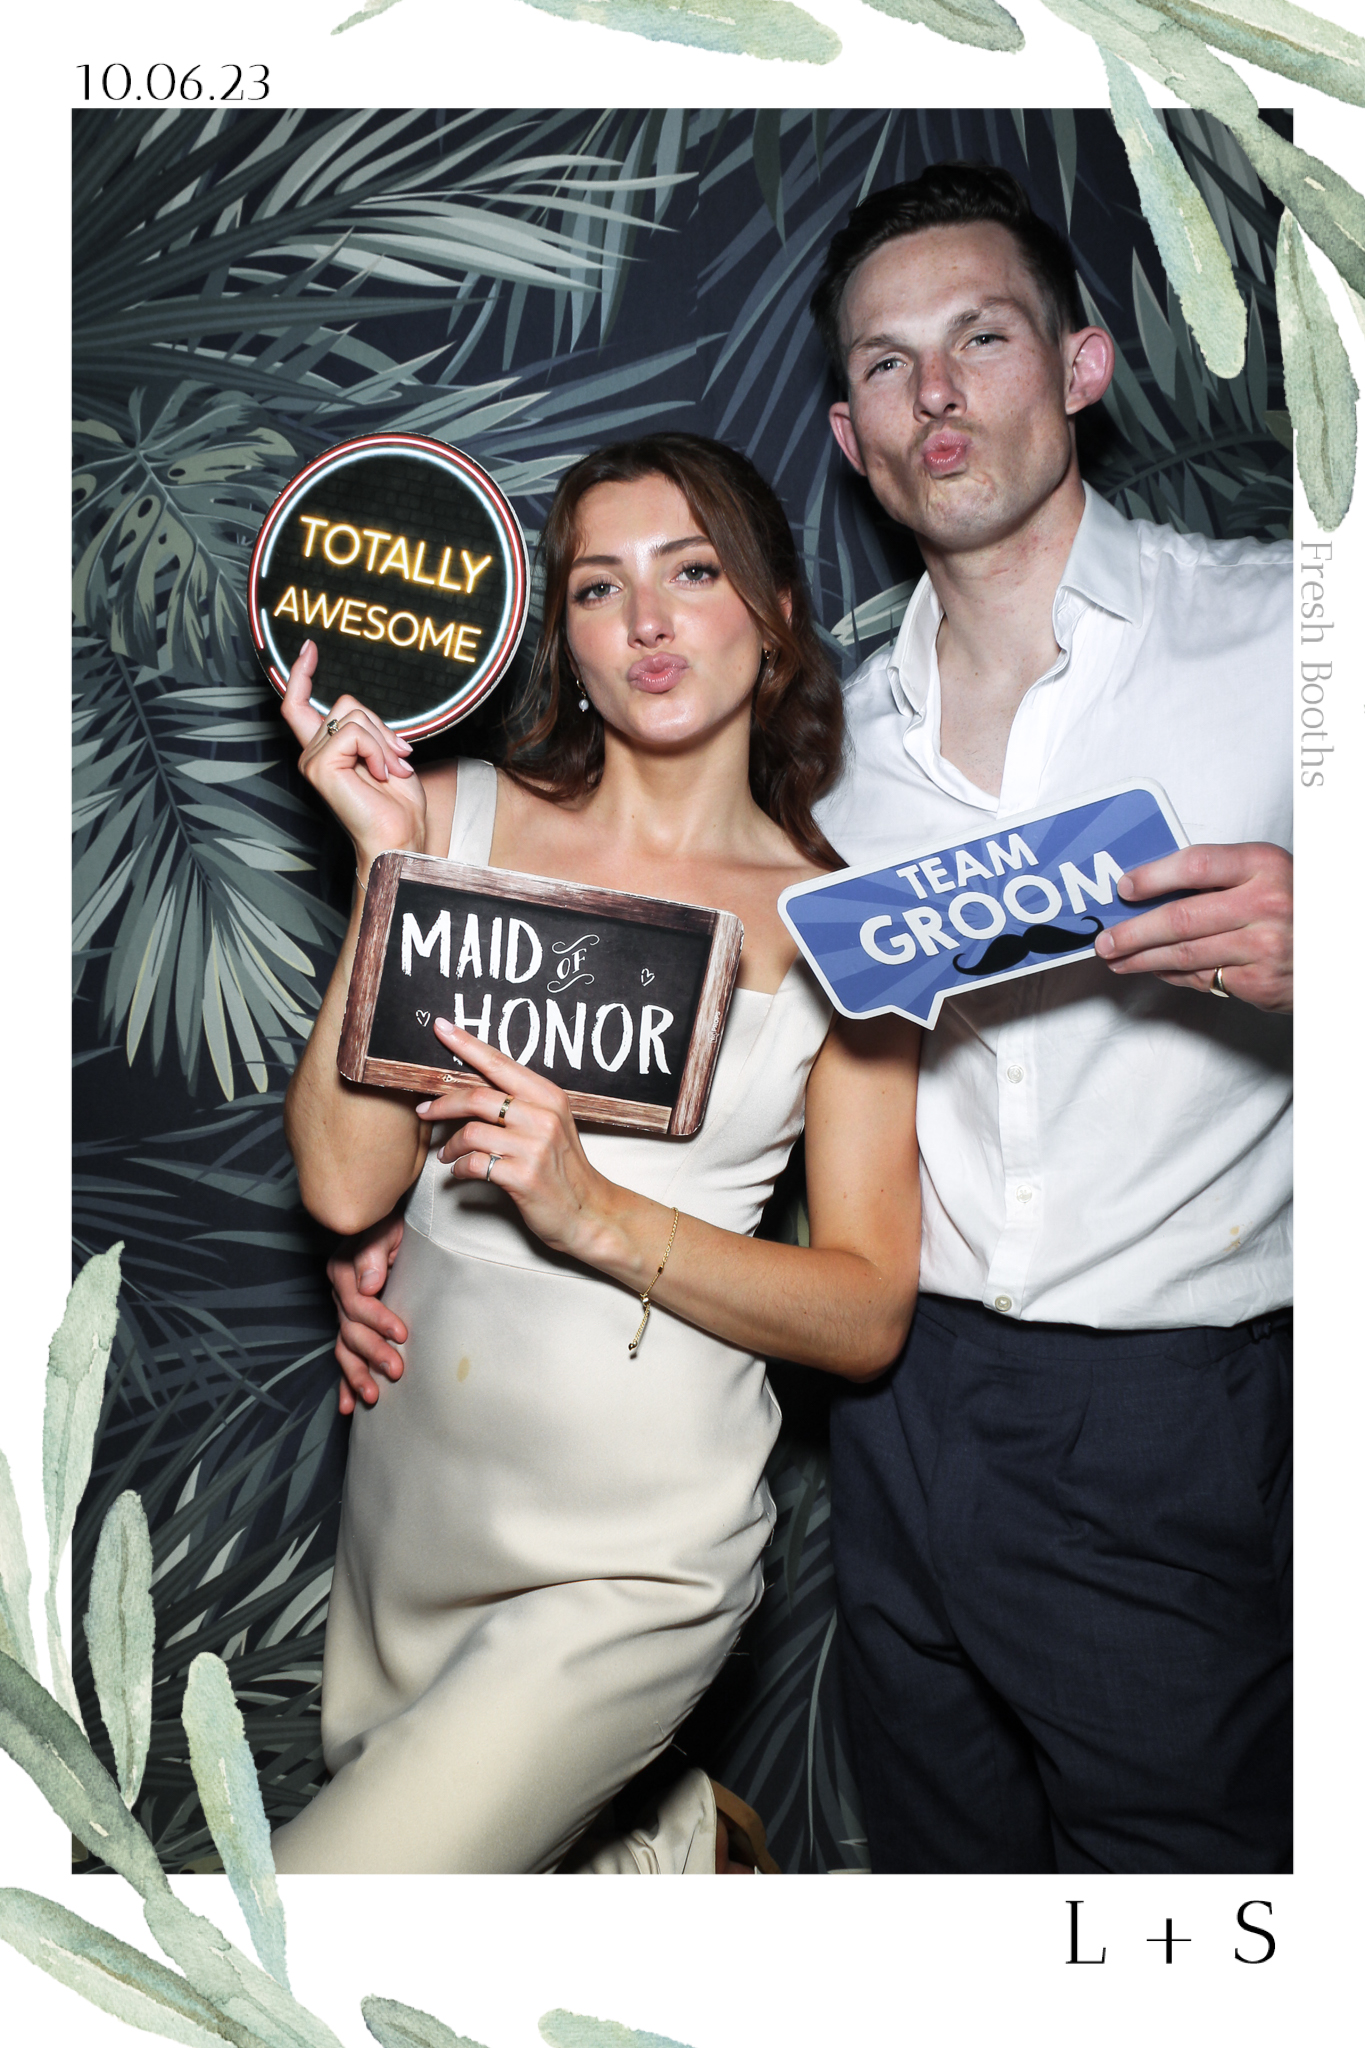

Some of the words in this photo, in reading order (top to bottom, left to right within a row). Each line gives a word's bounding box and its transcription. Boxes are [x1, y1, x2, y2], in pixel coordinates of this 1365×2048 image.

[300, 515, 492, 594] TOTALLY
[273, 585, 482, 663] AWESOME
[896, 833, 1039, 900] TEAM
[401, 909, 544, 984] MAID
[859, 850, 1125, 966] GROOM
[454, 993, 675, 1076] HONOR
